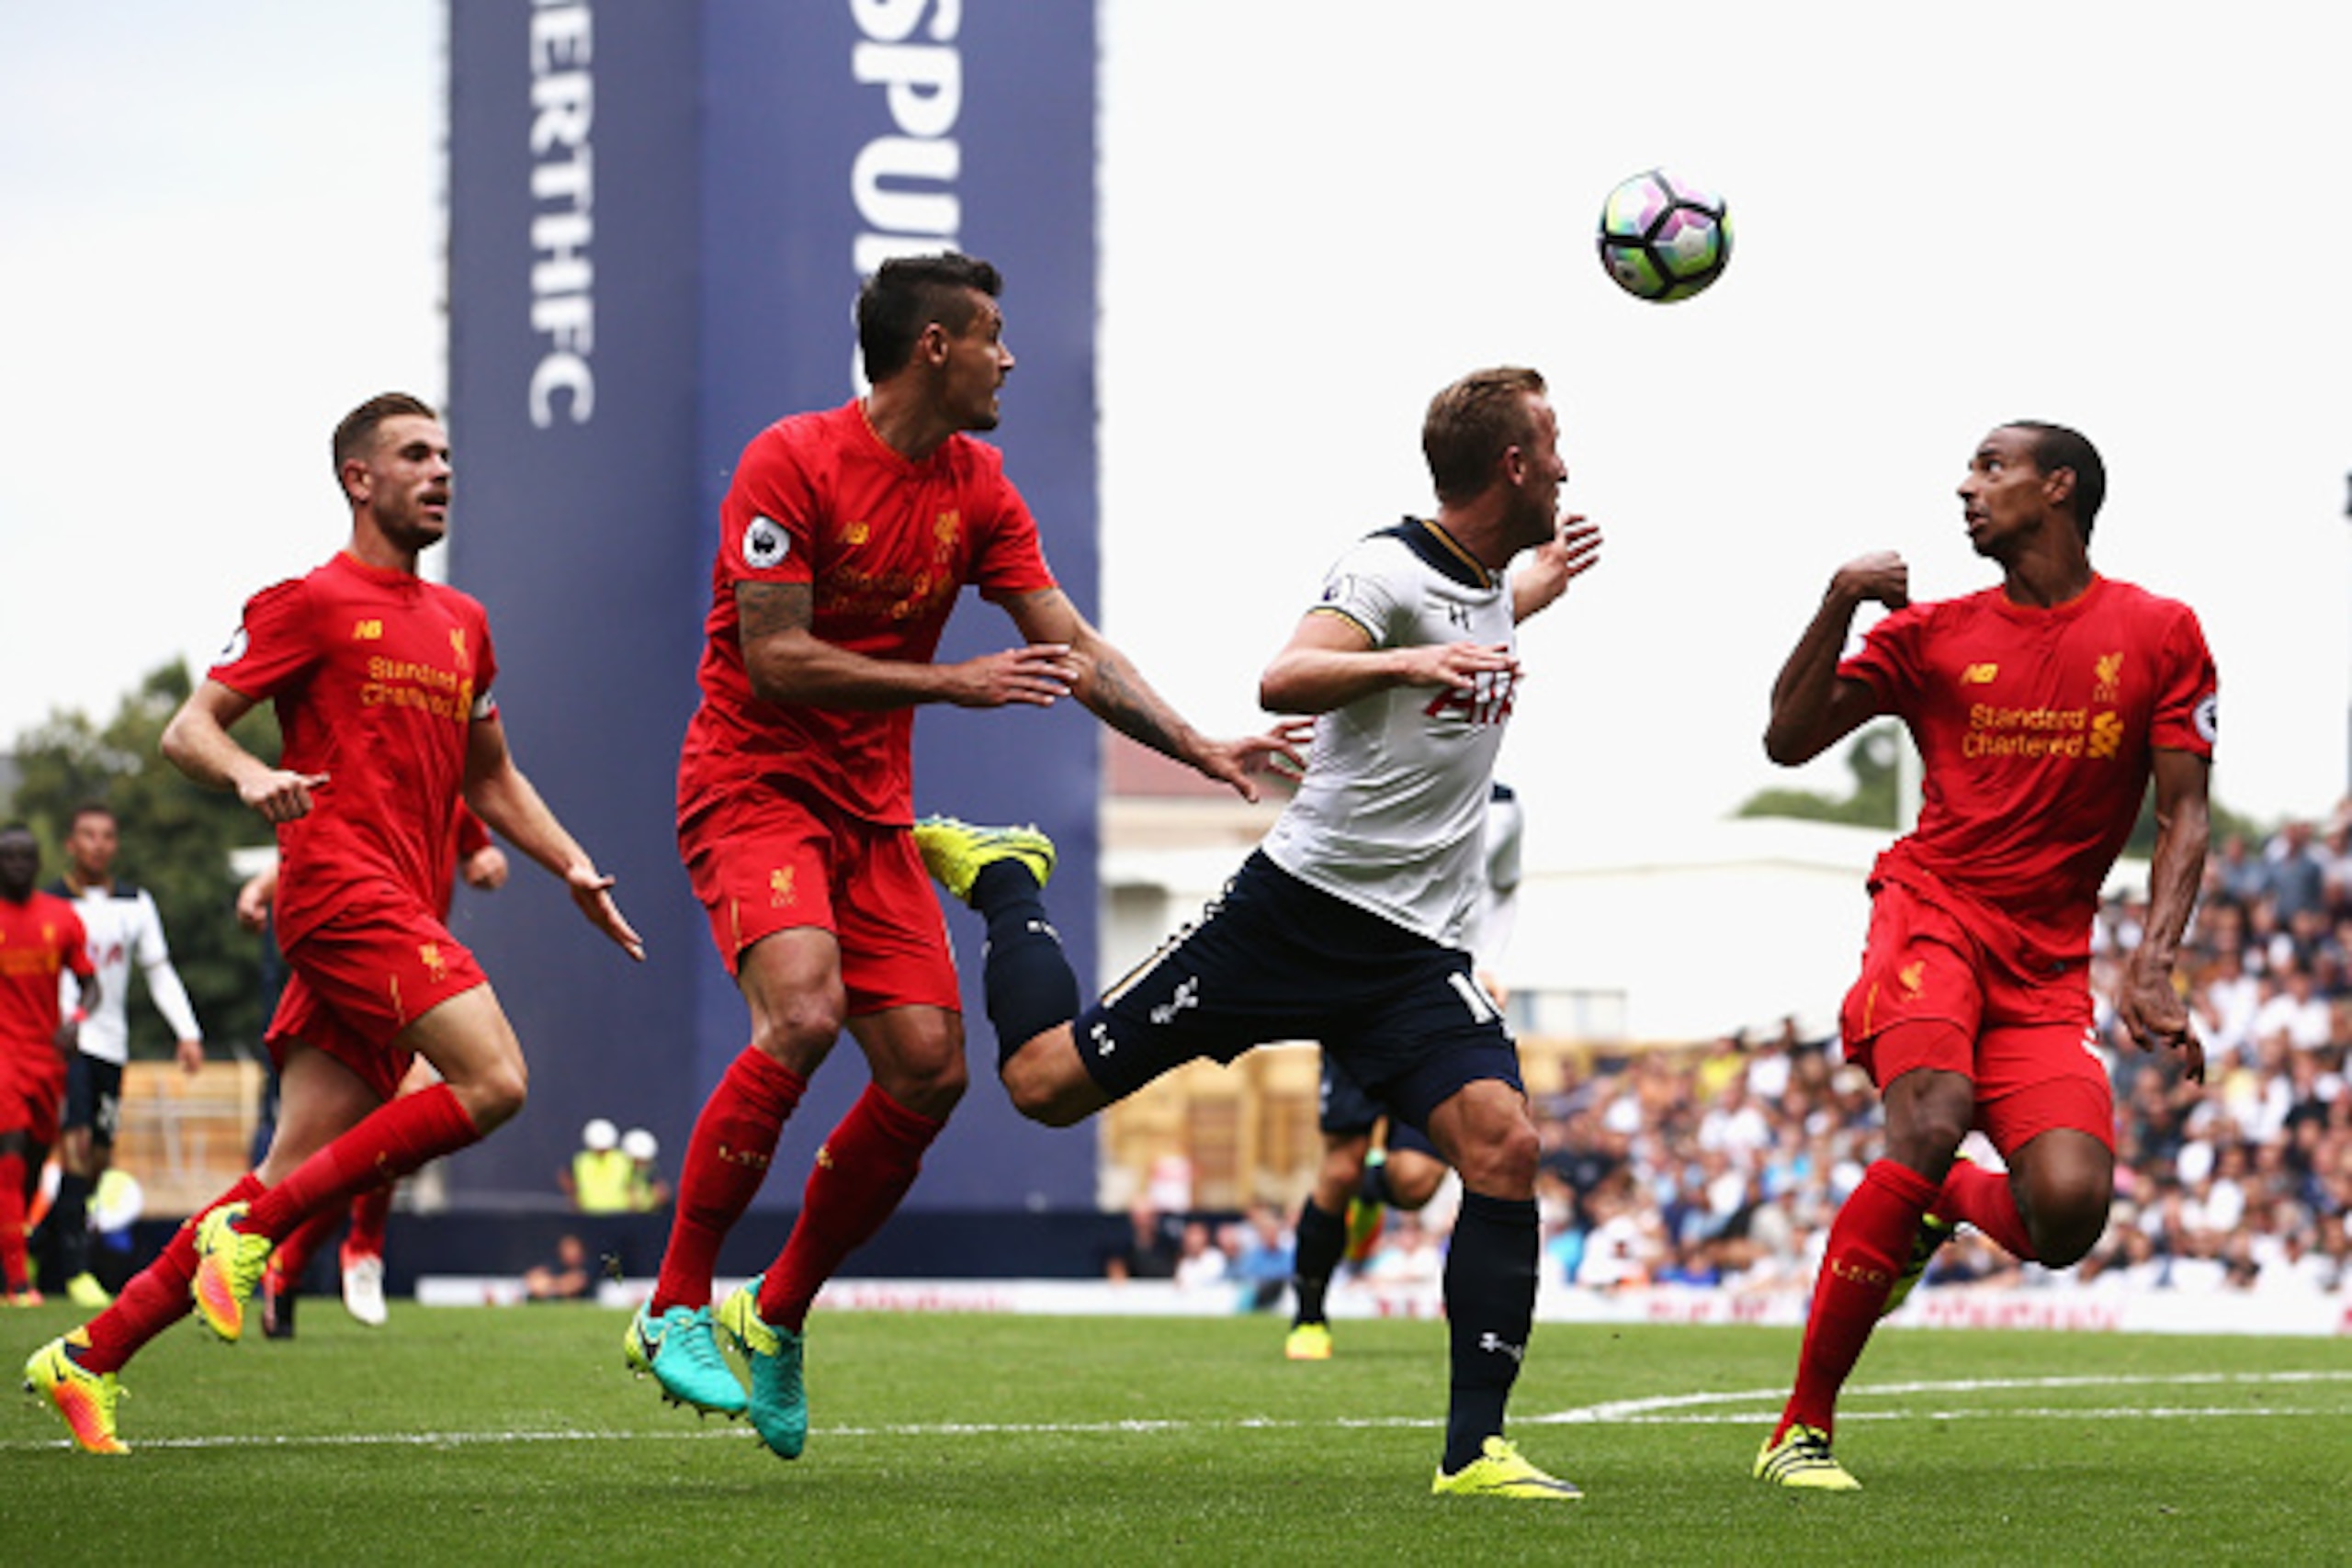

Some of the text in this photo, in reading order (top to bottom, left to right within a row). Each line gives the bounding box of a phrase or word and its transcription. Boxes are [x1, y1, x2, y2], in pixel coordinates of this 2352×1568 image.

[529, 0, 594, 429] ERTHFC
[1970, 703, 2087, 730] Standard
[1962, 732, 2085, 759] Chartered
